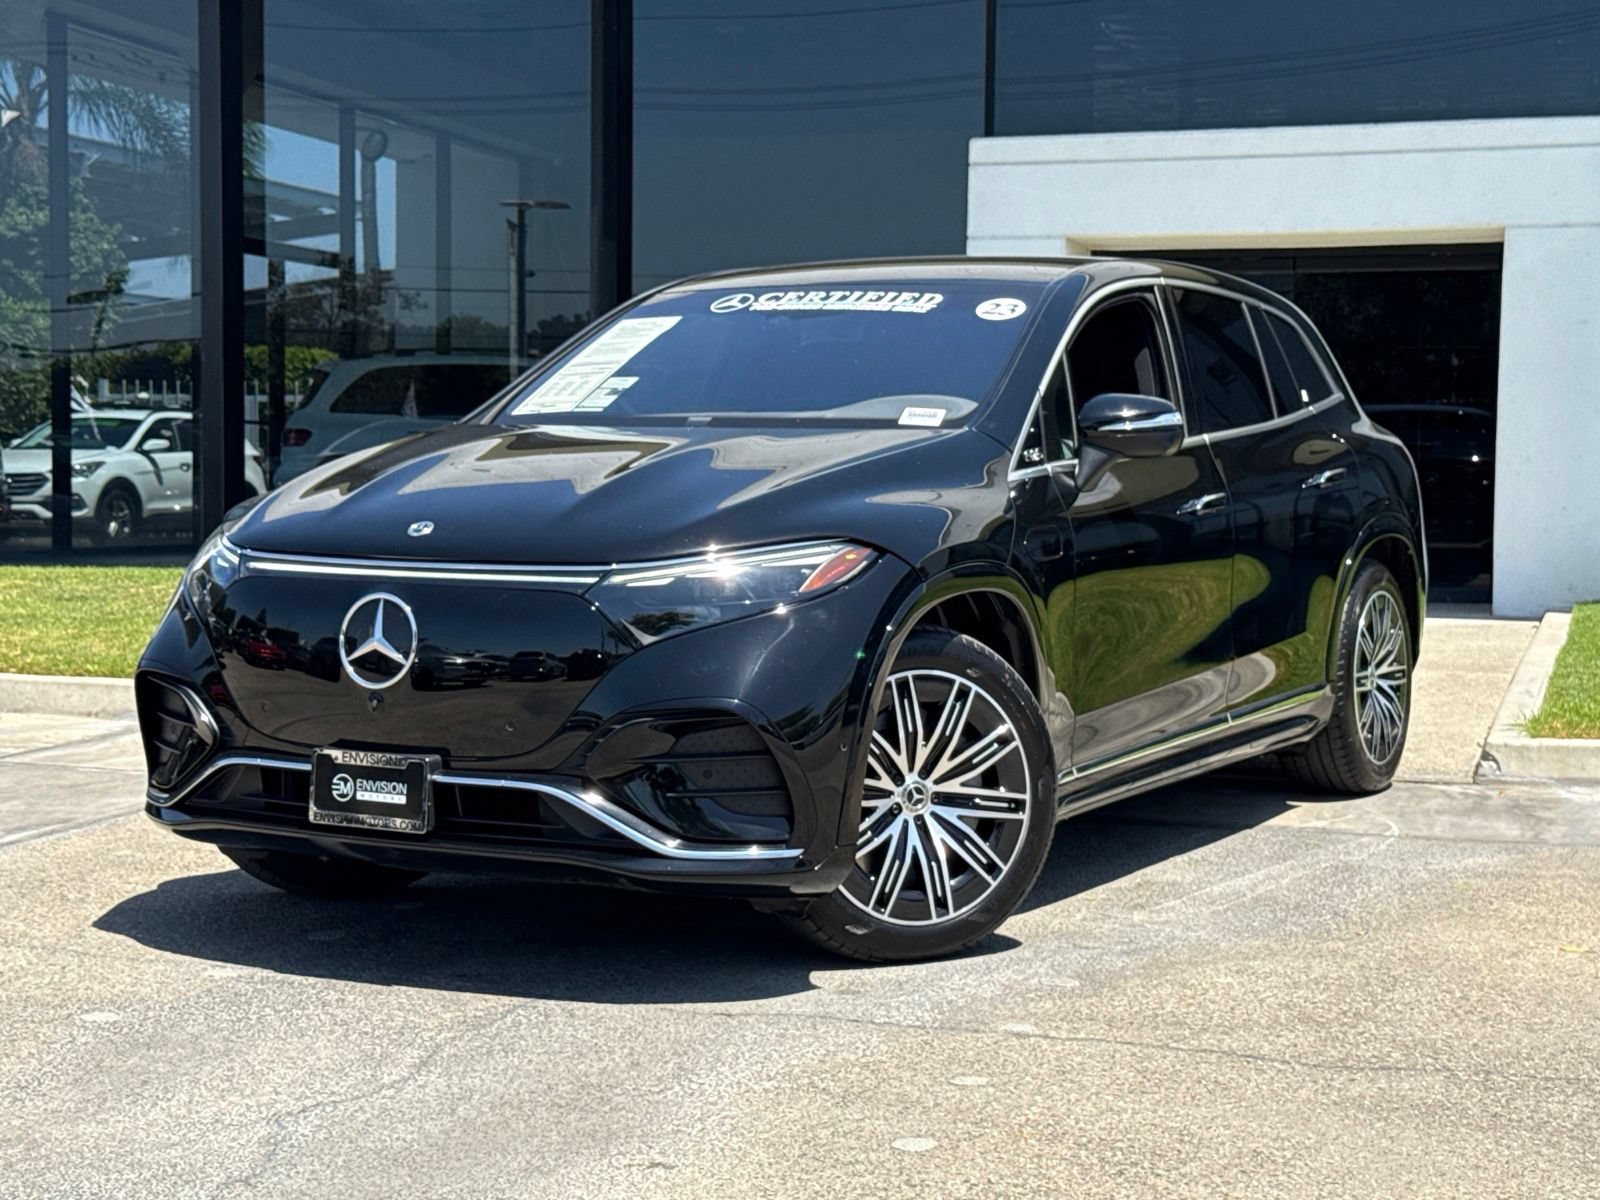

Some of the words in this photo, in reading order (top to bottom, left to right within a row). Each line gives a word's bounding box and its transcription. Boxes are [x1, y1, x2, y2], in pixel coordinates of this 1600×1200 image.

[758, 291, 944, 306] CERTIFIED
[981, 302, 1018, 315] 23
[342, 751, 399, 766] ENVISION
[356, 778, 407, 795] ENVISION
